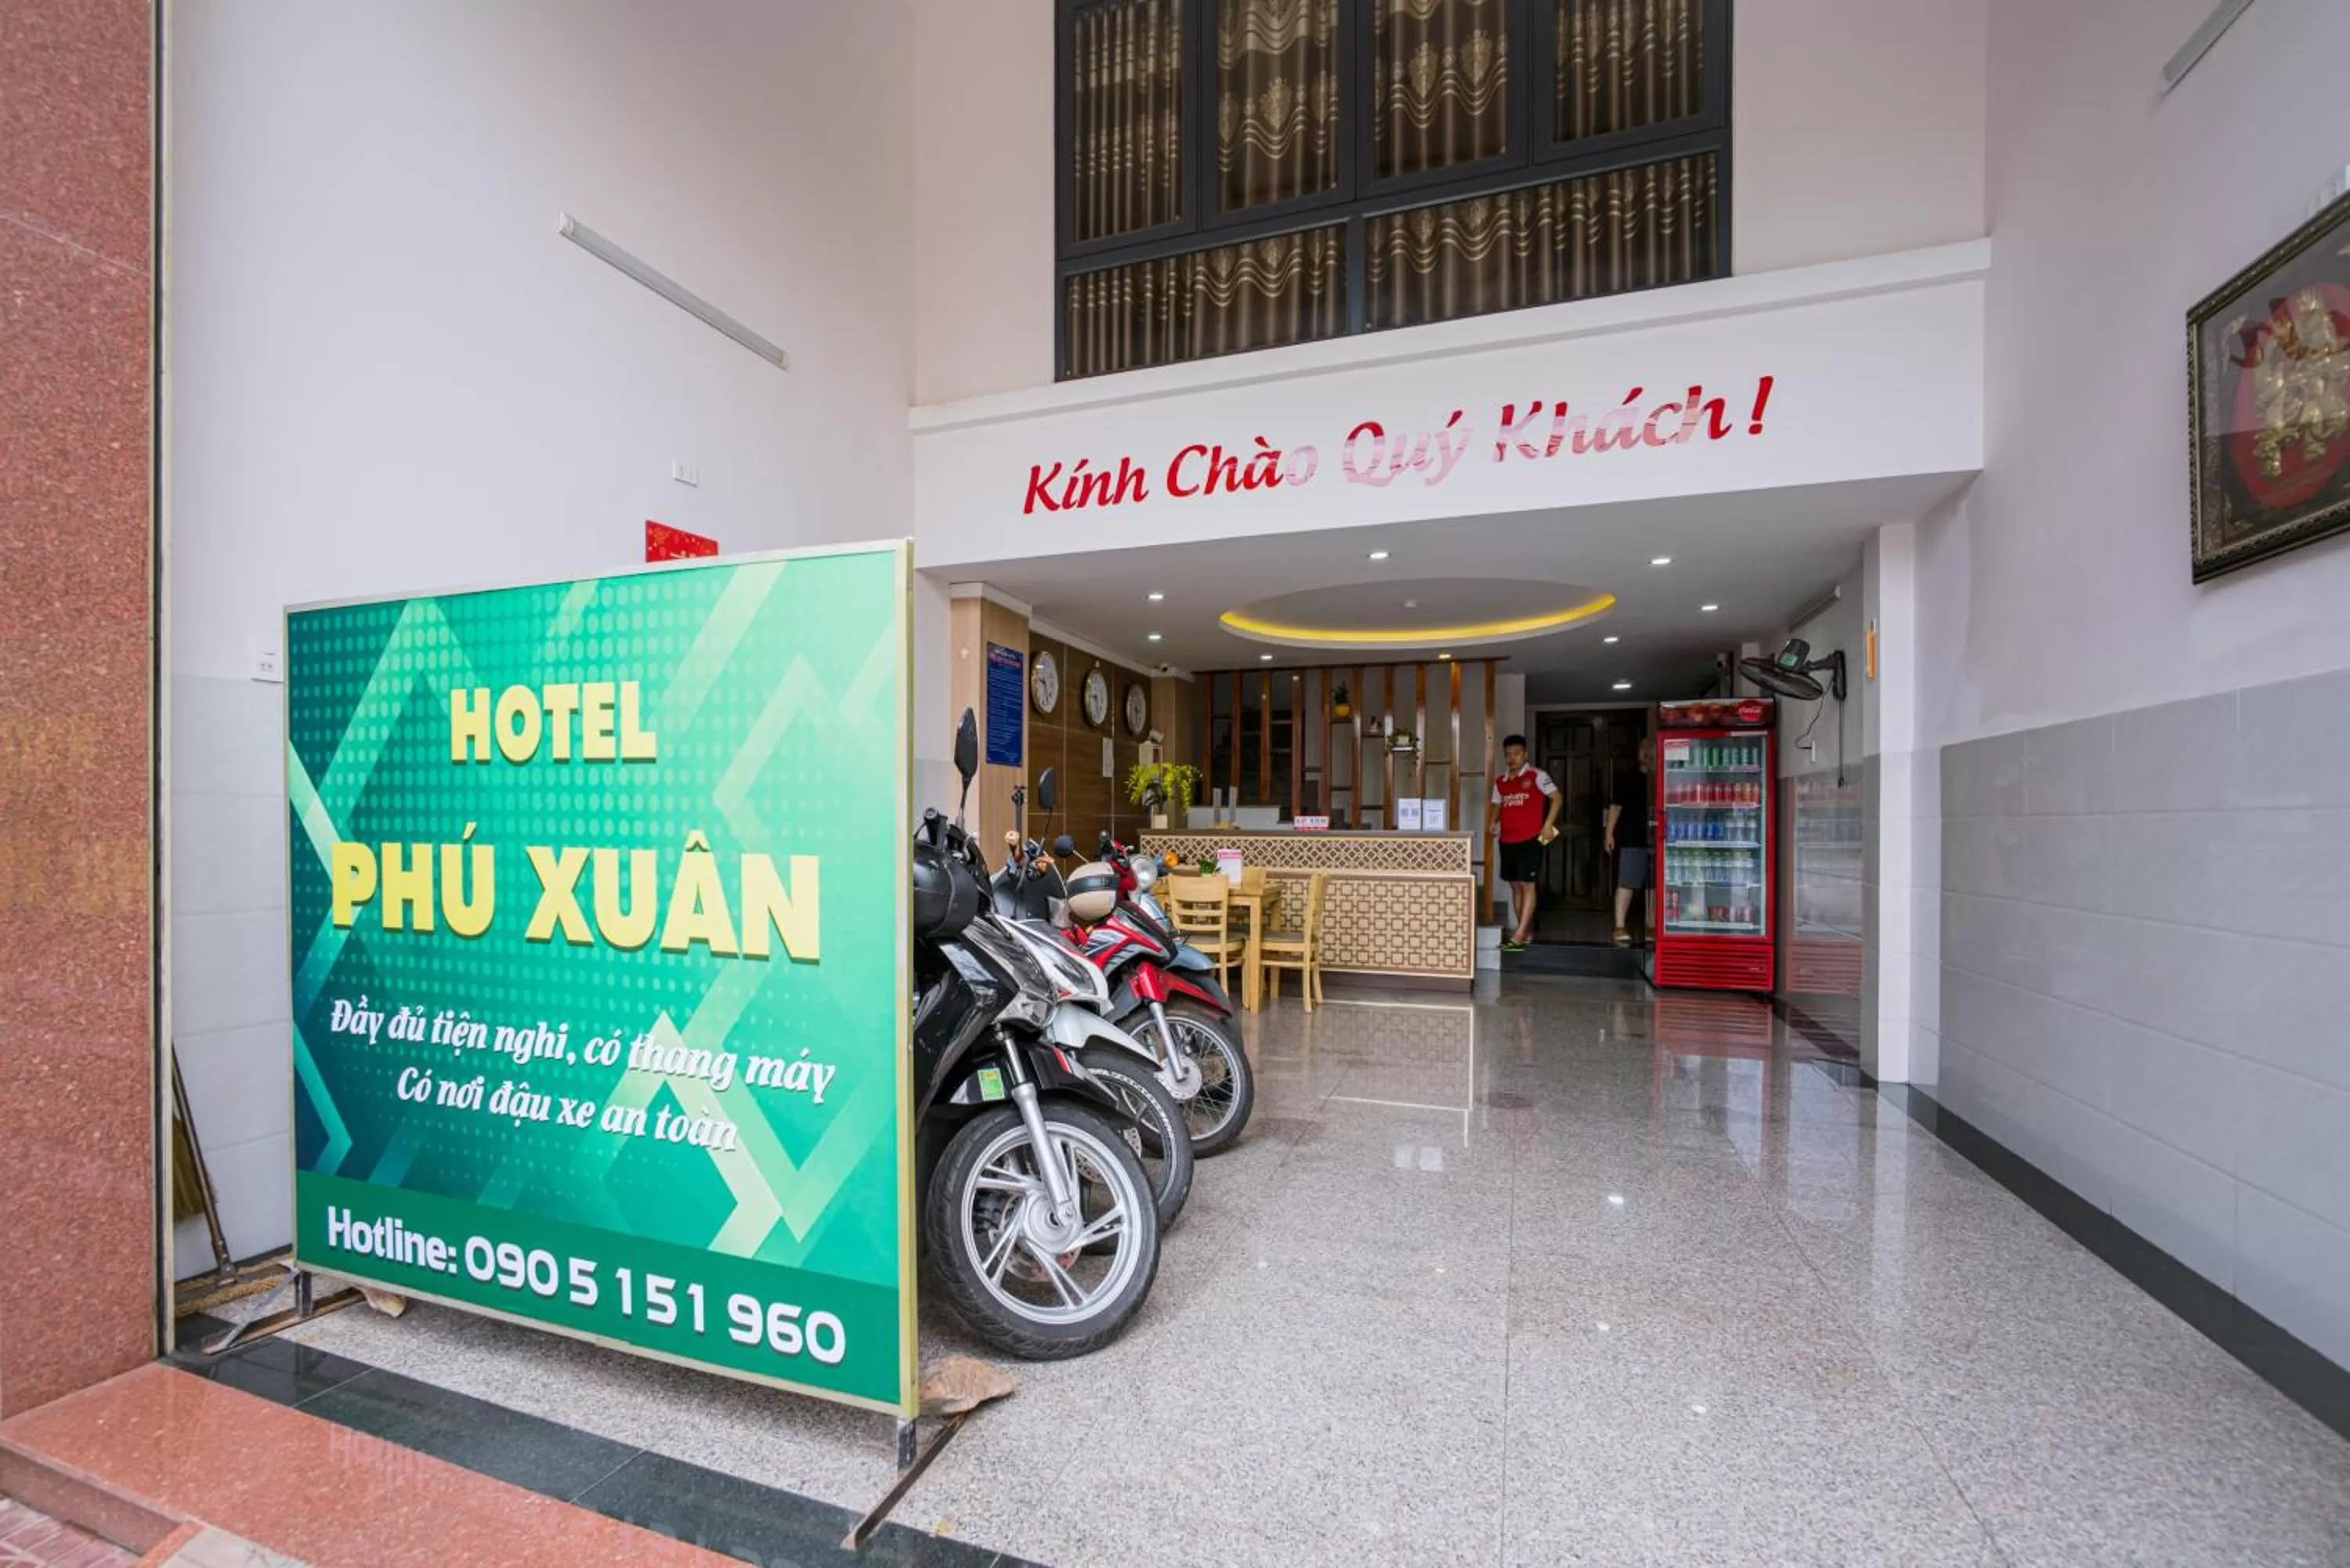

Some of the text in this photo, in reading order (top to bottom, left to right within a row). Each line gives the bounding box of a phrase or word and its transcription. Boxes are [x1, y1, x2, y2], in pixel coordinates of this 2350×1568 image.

[1023, 457, 1149, 514] Kính
[1166, 436, 1318, 497] Chào
[1342, 409, 1473, 486] Quý
[1493, 385, 1733, 462] Khách
[450, 681, 657, 764] HOTEL
[331, 822, 821, 965] PHÚ XUÂN
[331, 994, 836, 1105] Đầy đủ tiện nghi, có thang máy
[396, 1066, 738, 1152] Có nơi đậu xe an toàn
[327, 1205, 457, 1274] Hotline:
[726, 1292, 847, 1365] 960
